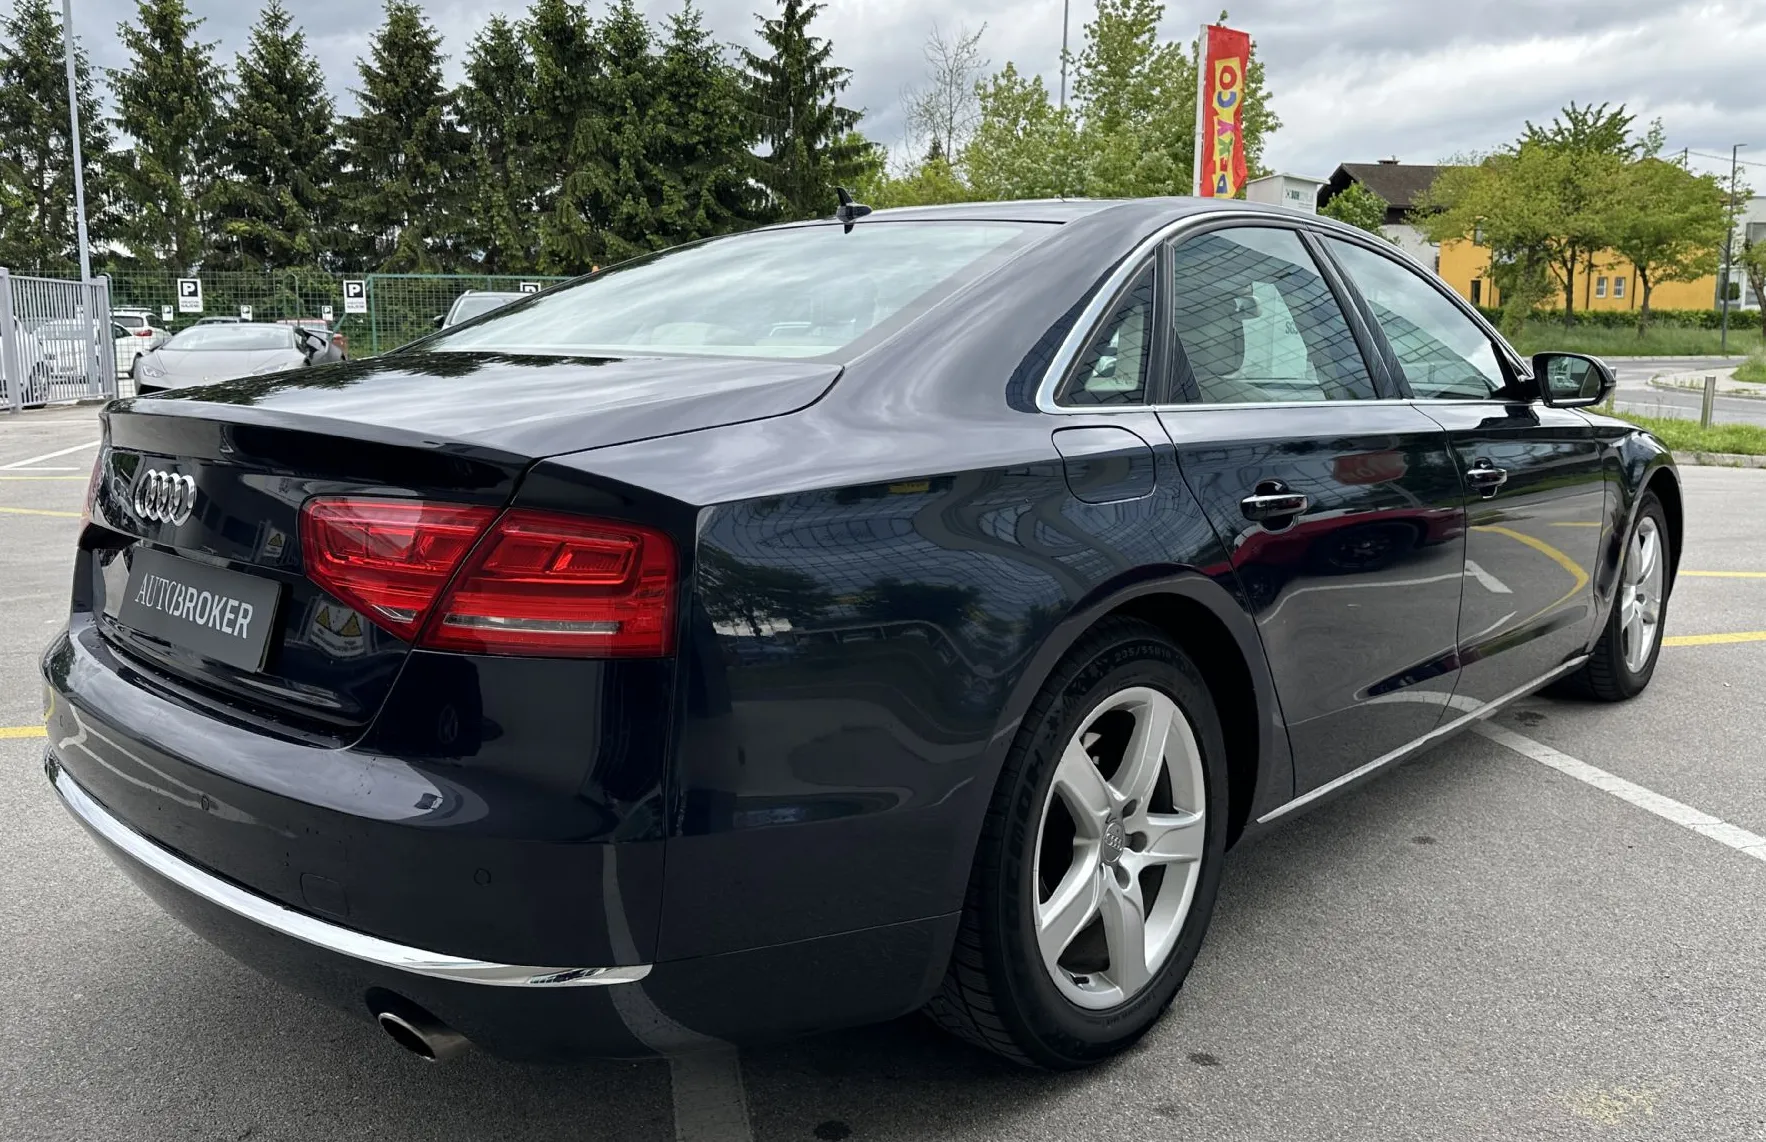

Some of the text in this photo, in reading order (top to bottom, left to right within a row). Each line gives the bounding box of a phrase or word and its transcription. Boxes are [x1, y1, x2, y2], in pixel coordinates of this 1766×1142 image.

[1217, 65, 1237, 108] CO
[182, 282, 195, 296] P
[348, 284, 361, 296] P
[135, 573, 253, 639] AUTOBROKER
